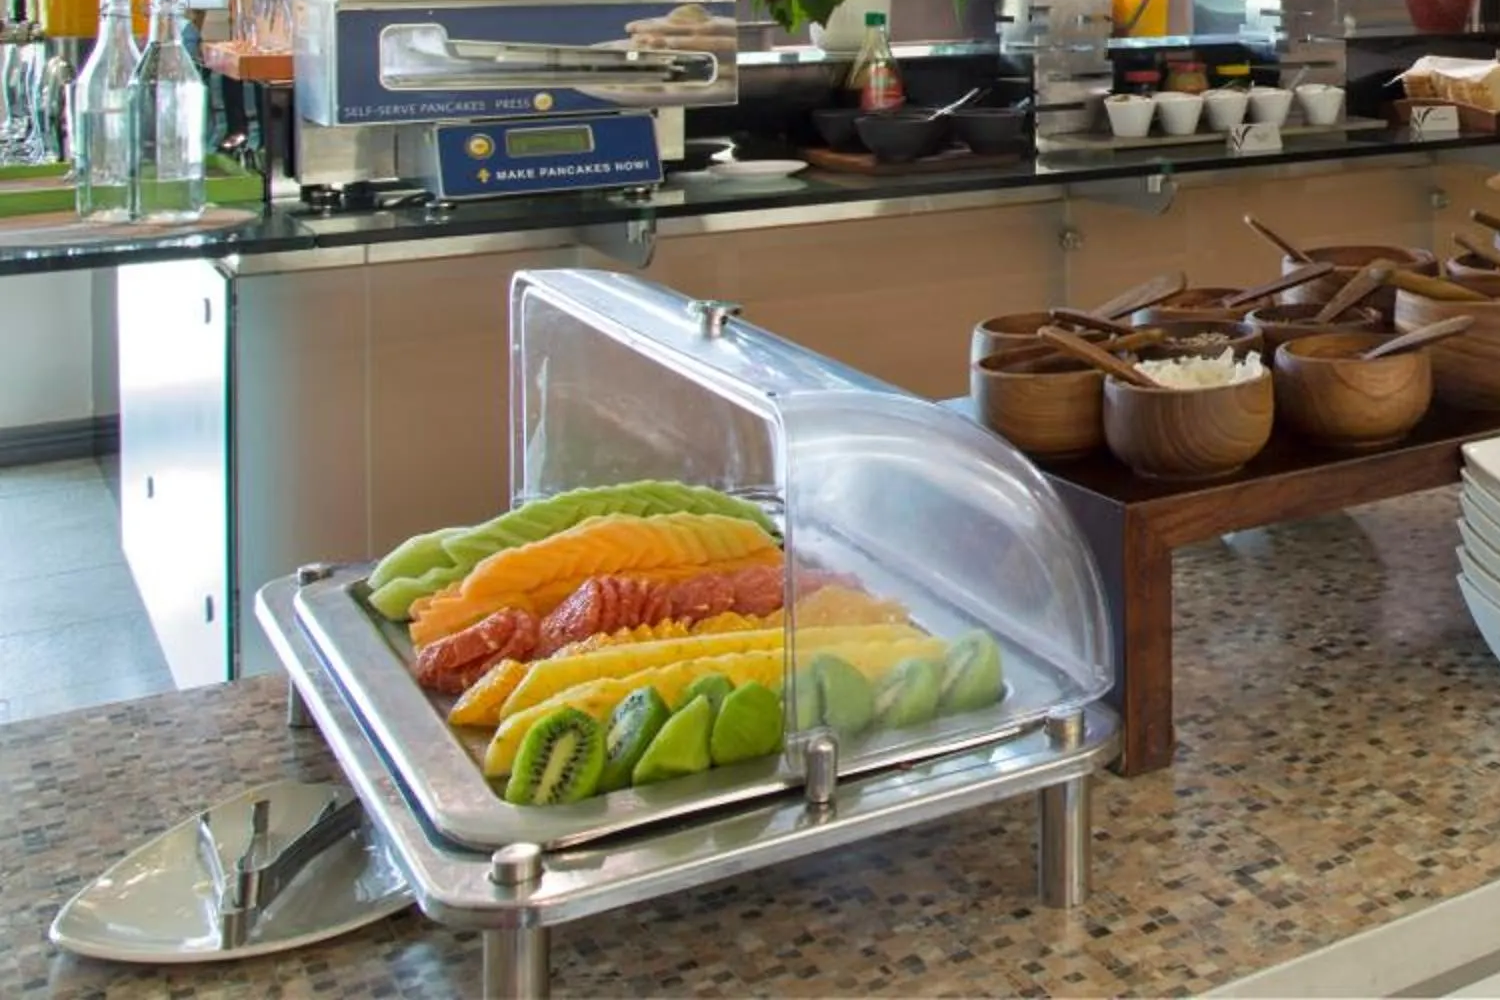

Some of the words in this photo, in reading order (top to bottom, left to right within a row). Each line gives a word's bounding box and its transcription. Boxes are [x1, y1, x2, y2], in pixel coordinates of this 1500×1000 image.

[343, 104, 417, 118] SELF-SERVE
[495, 99, 530, 111] PRESS
[497, 168, 536, 180] MAKE
[540, 163, 611, 178] PANCAKES
[615, 159, 650, 171] NOW!
